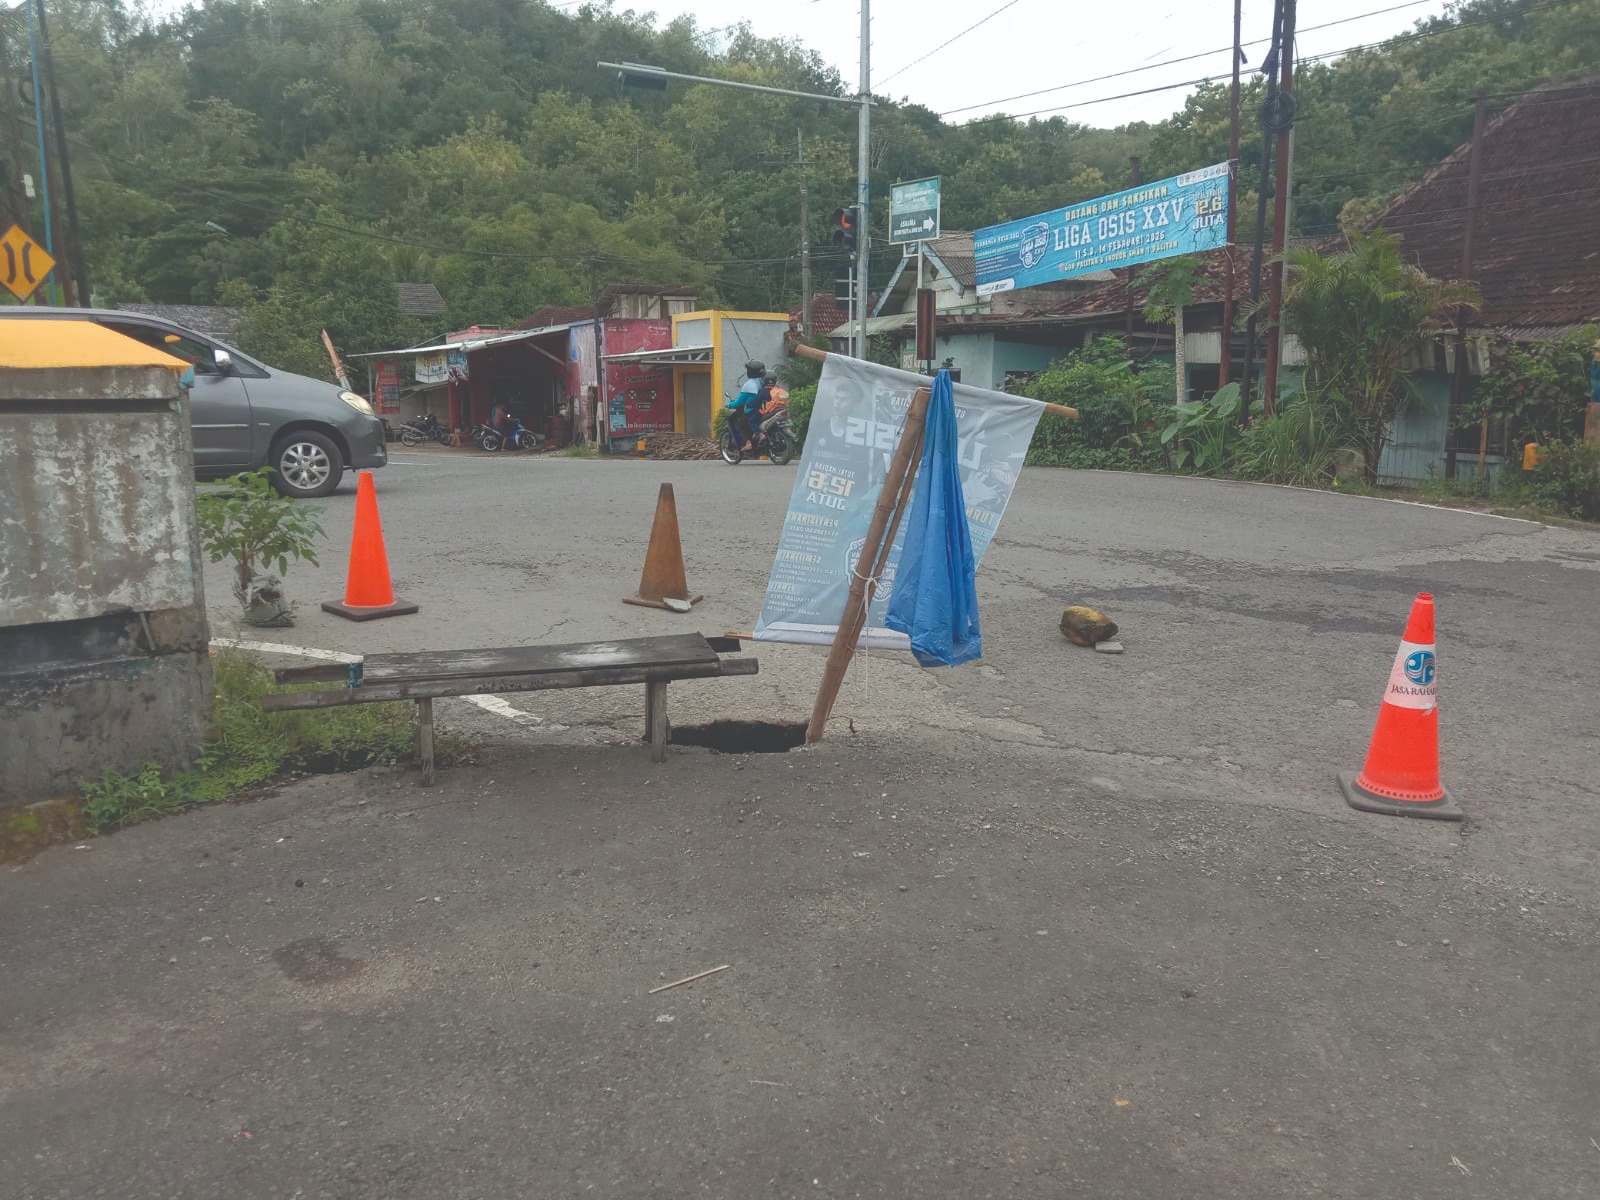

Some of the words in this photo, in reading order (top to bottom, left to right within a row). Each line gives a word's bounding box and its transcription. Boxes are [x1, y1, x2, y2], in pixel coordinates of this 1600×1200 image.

[1065, 204, 1098, 221] DATANG
[1101, 198, 1119, 212] DAN
[1122, 185, 1168, 206] SAKSIKAN
[1195, 197, 1223, 216] 12,6
[1053, 222, 1092, 251] LIGA
[1098, 210, 1136, 240] OSIS
[1142, 197, 1185, 230] XXV
[1193, 213, 1225, 231] JUTA
[1108, 236, 1143, 250] FEBRUARI
[1391, 684, 1410, 695] JASA
